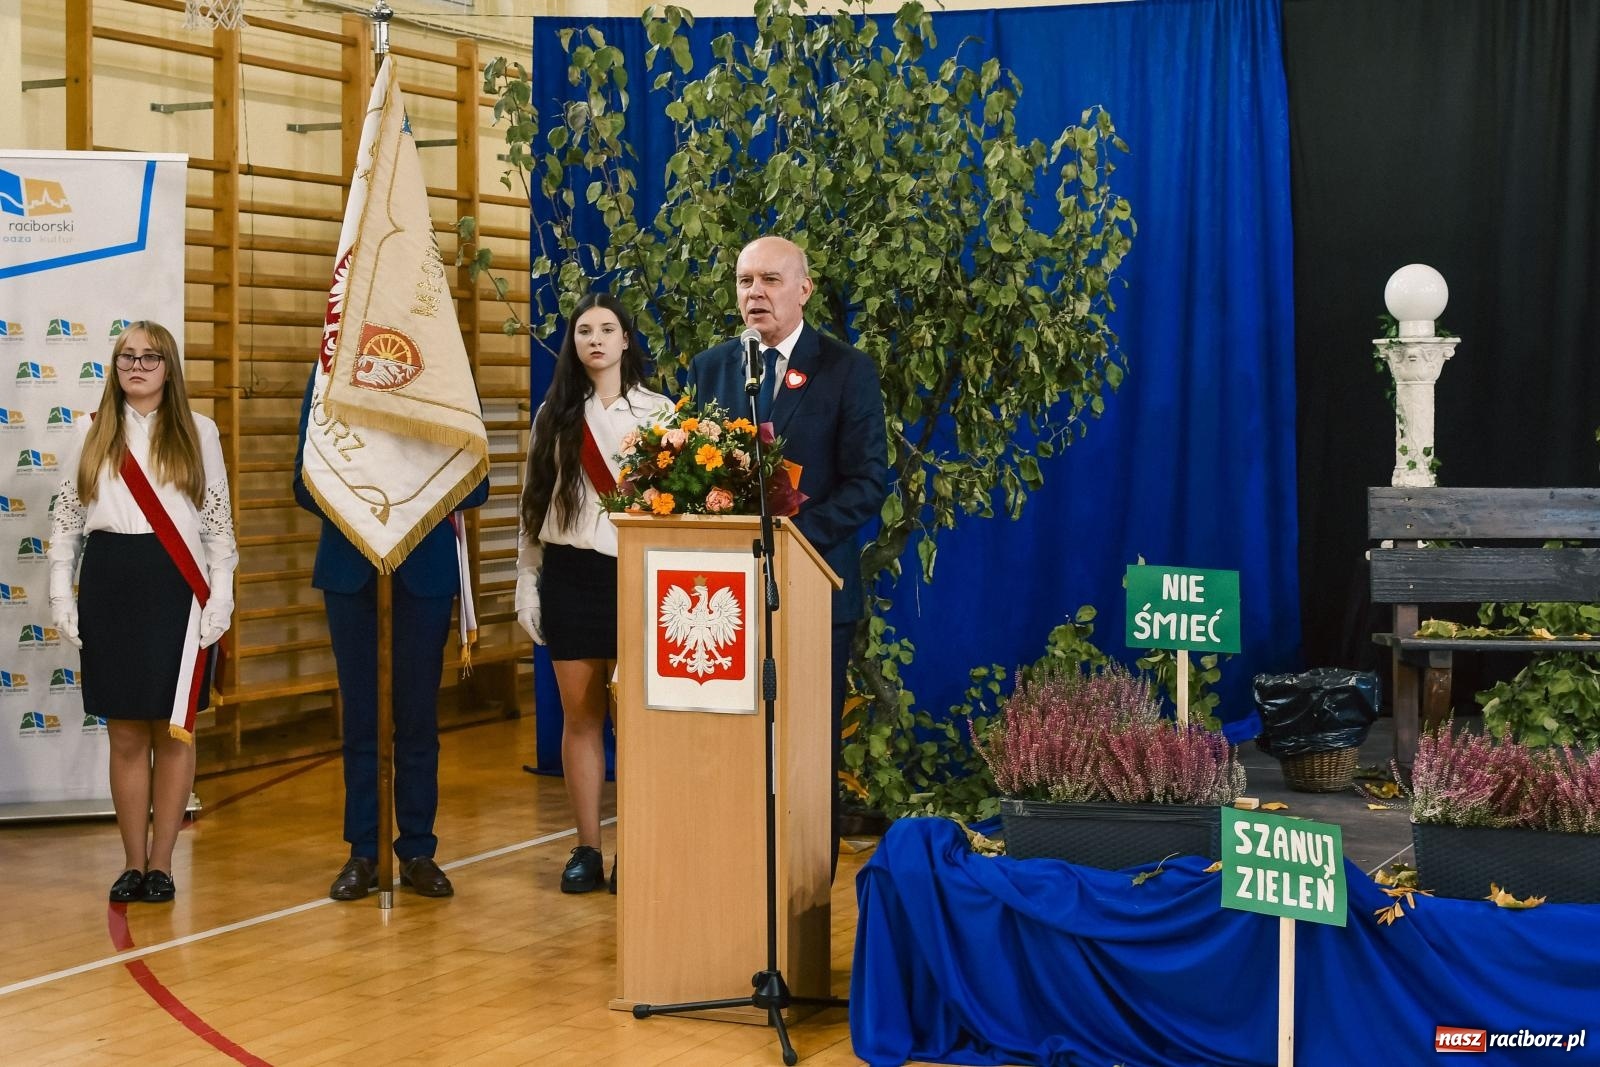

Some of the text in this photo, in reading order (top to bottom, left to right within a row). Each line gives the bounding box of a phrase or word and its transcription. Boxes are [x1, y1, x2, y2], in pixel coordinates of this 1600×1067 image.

[8, 219, 75, 232] raciborski
[1162, 573, 1205, 603] NIE
[1133, 602, 1223, 643] ŚMIEĆ
[1233, 820, 1336, 876] SZANUJ
[1235, 865, 1335, 913] ZIELEŃ
